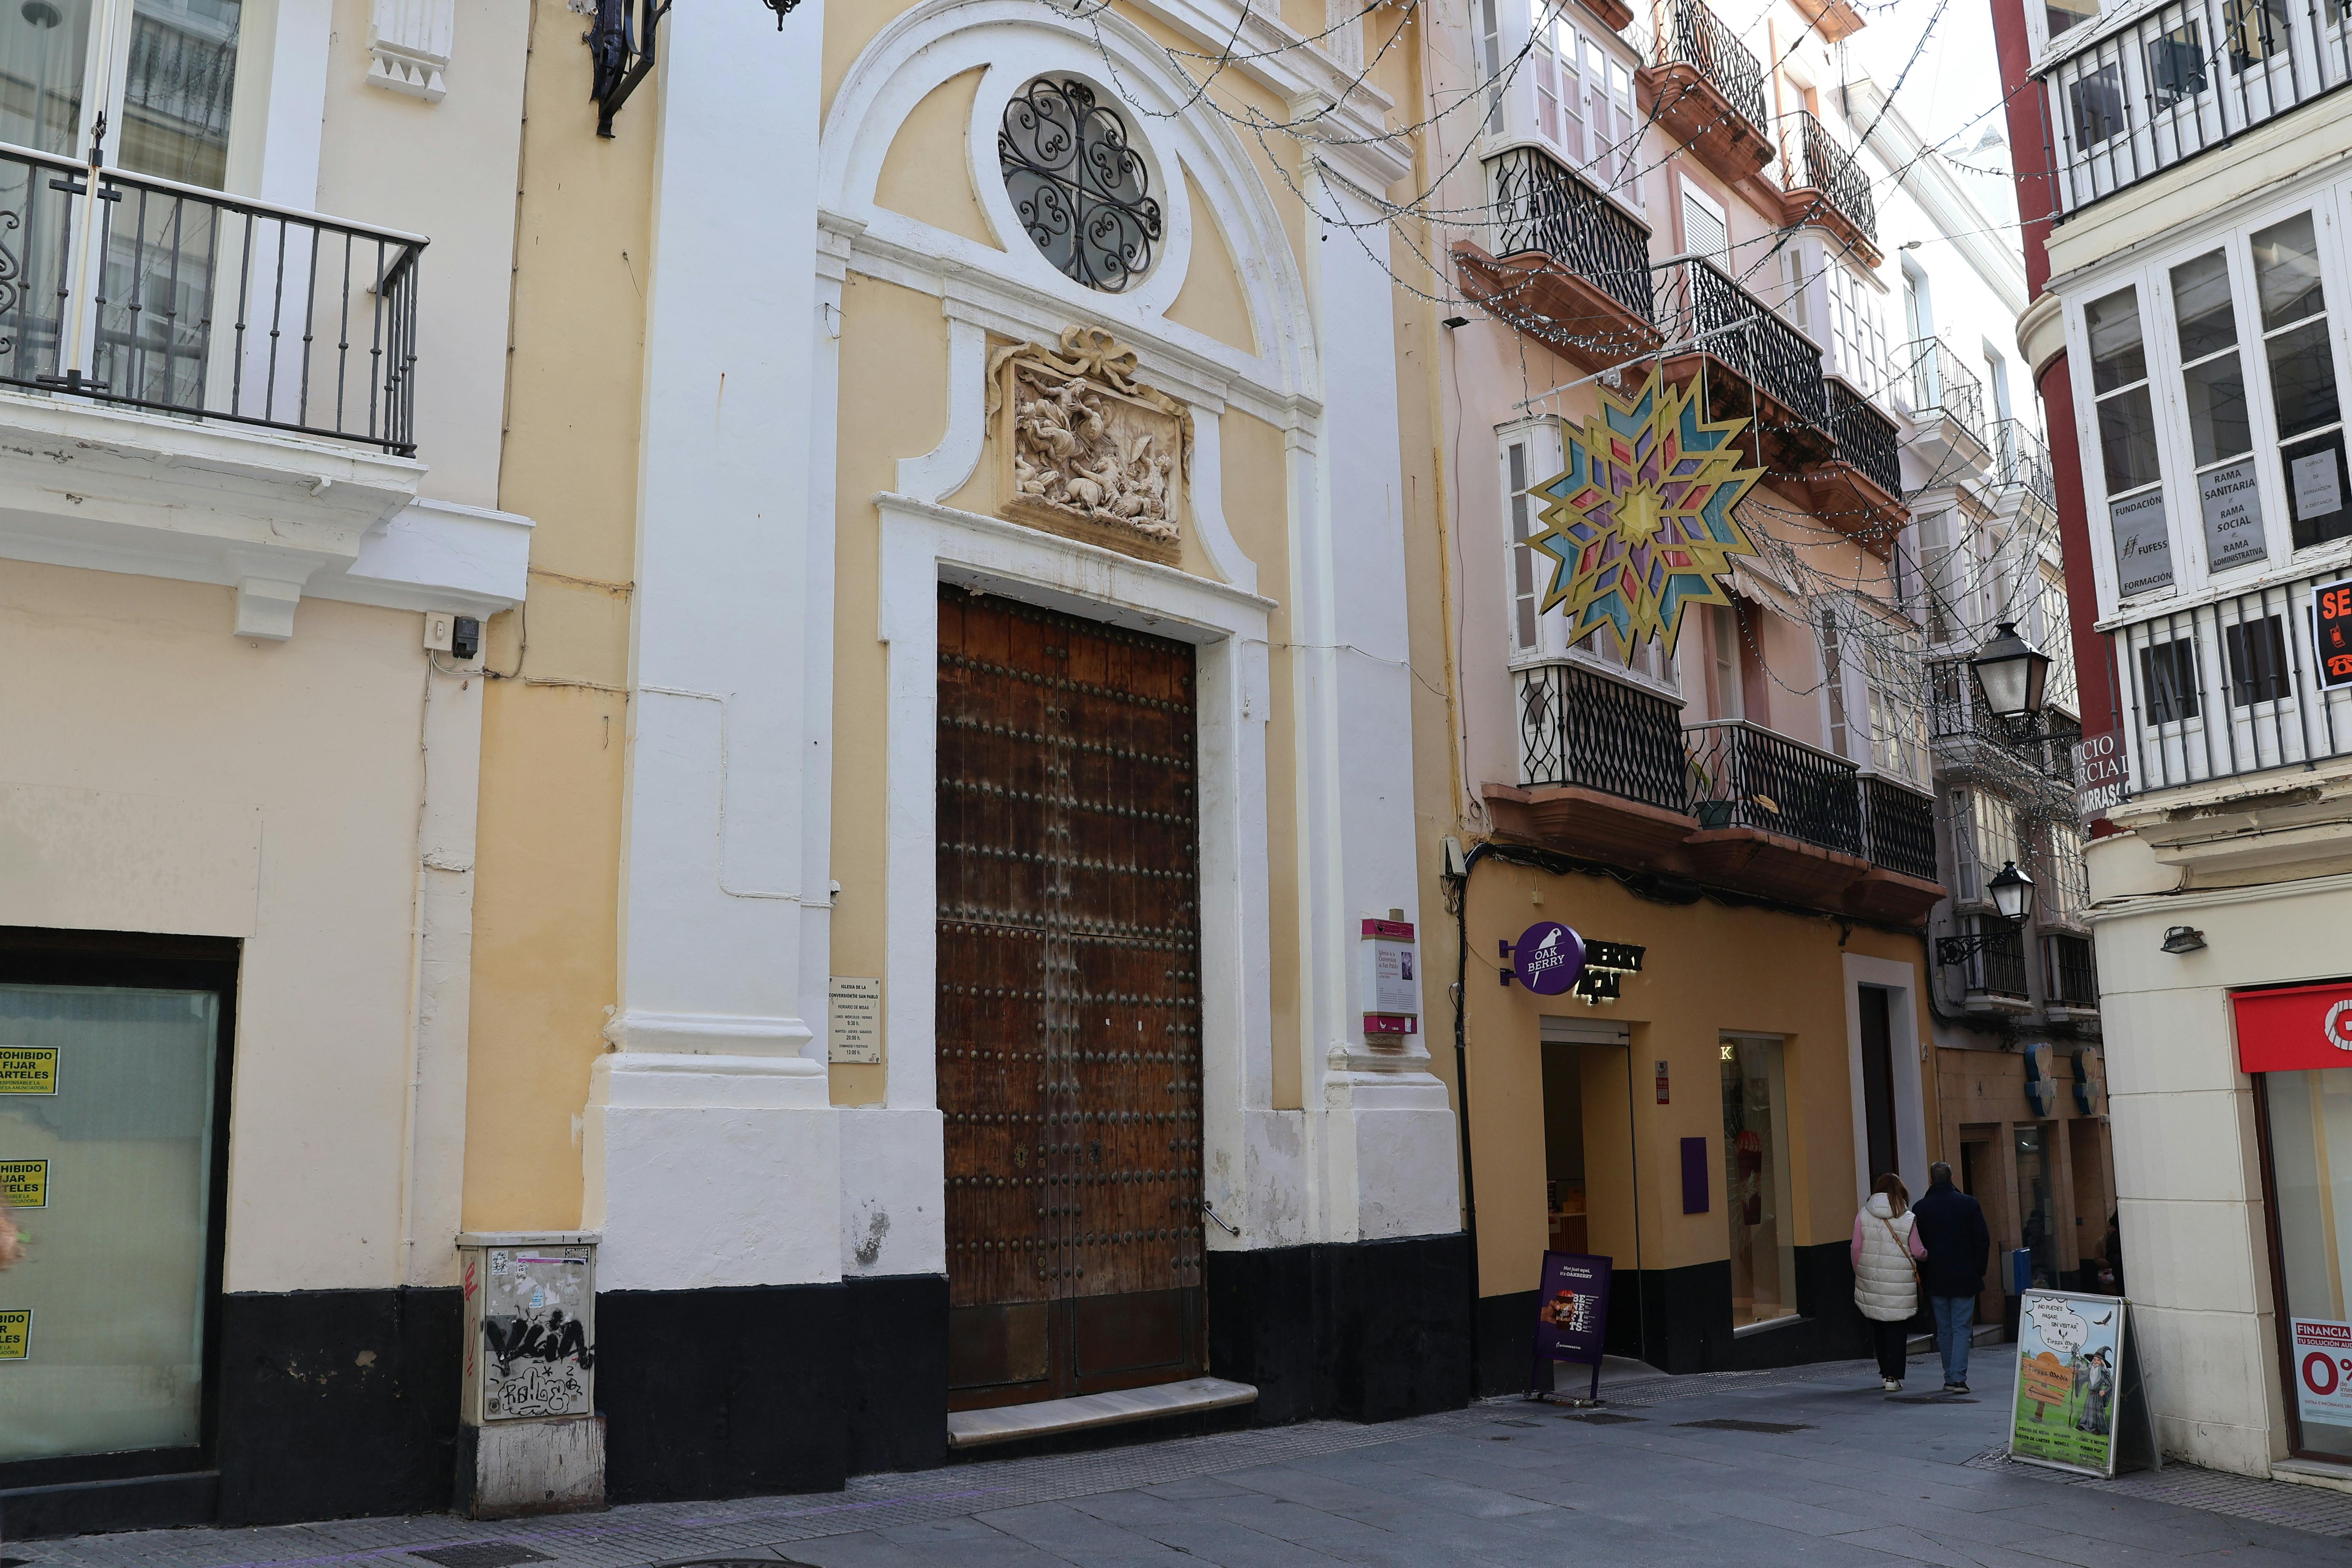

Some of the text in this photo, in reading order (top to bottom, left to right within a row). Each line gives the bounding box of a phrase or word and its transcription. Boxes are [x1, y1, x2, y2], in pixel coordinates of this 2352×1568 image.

[2305, 459, 2323, 467] CURSOS
[2214, 470, 2241, 483] RAMA
[2205, 479, 2255, 500] SANITARIA
[2304, 485, 2331, 495] FORMACIÓN
[2116, 495, 2161, 516] FUNDACIÓN
[2310, 498, 2333, 508] DISTANCIA
[2221, 505, 2245, 518] RAMA
[2217, 515, 2251, 532] SOCIAL
[2138, 540, 2167, 555] FUFESS
[2223, 539, 2249, 553] RAMA
[2214, 547, 2263, 567] ADMINISTRATIVA
[2124, 572, 2172, 590] FORMACIÓN
[2323, 588, 2352, 619] SE
[2072, 736, 2114, 766] FICIO
[2074, 755, 2129, 789] ERCIAL
[1535, 946, 1557, 960] OAK
[1528, 954, 1565, 972] BERRY
[1719, 1047, 1732, 1060] K
[1924, 1045, 1928, 1059] 2
[1, 1165, 42, 1173] HIBIDO
[1573, 1294, 1586, 1303] BE
[1570, 1321, 1583, 1332] TS
[2298, 1325, 2350, 1338] FINANCIA
